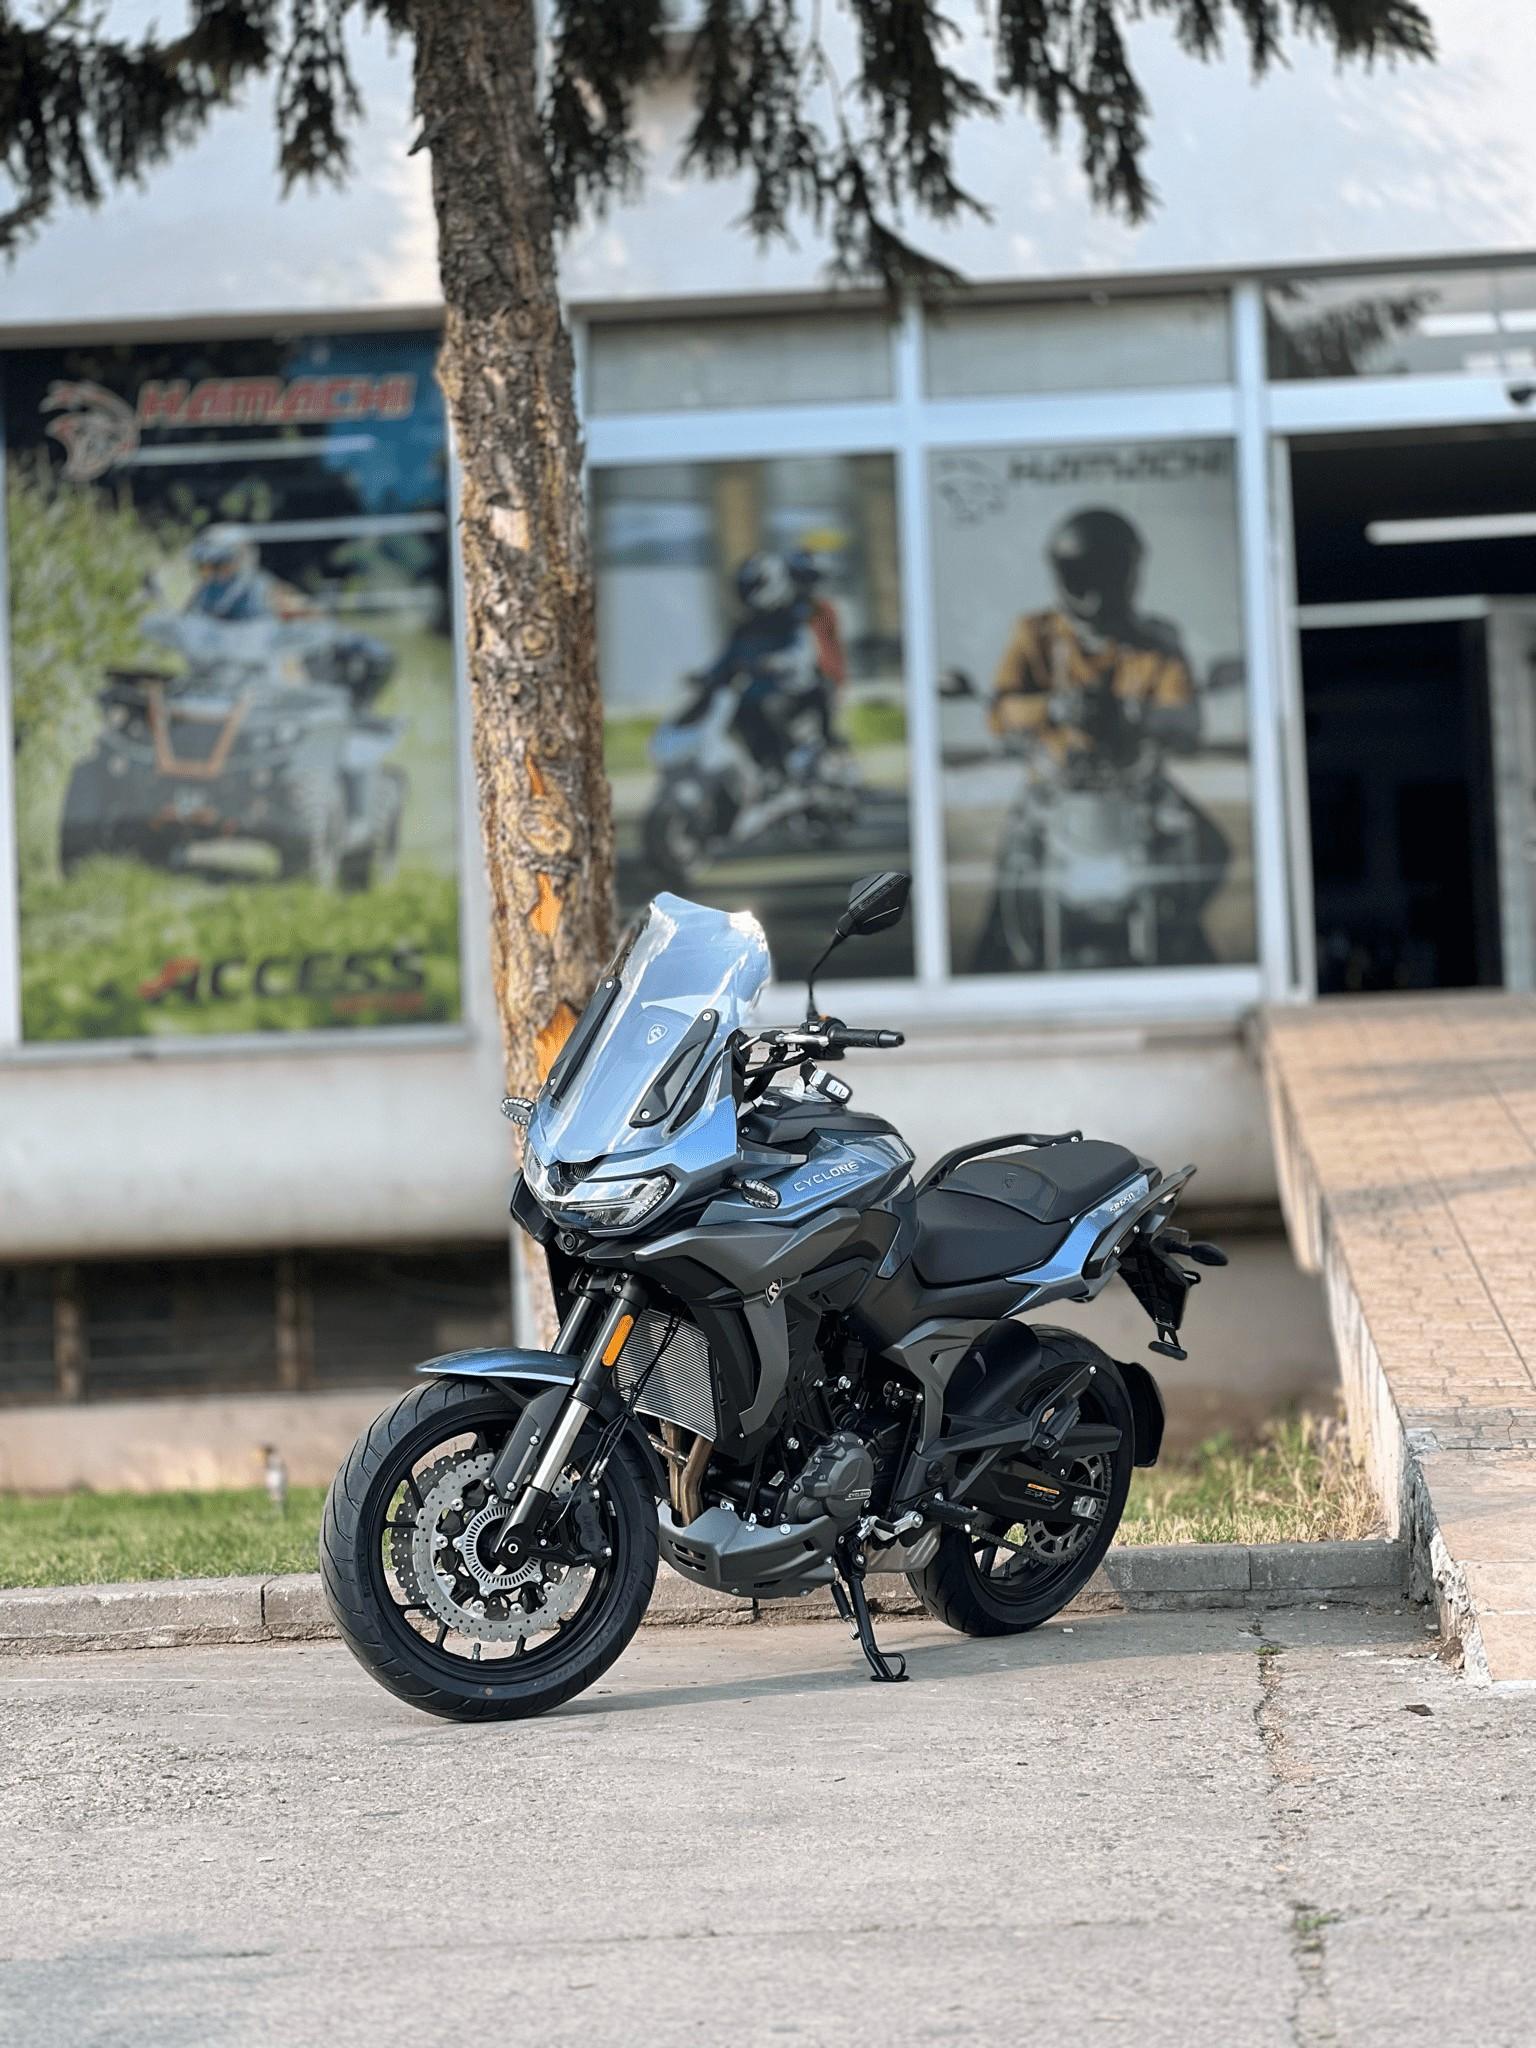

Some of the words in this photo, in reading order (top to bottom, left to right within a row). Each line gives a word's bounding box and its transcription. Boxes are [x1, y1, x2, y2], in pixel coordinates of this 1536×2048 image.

[138, 374, 415, 427] HAMACHI
[139, 947, 425, 1002] ACCESS
[793, 1160, 860, 1192] CYCLONE
